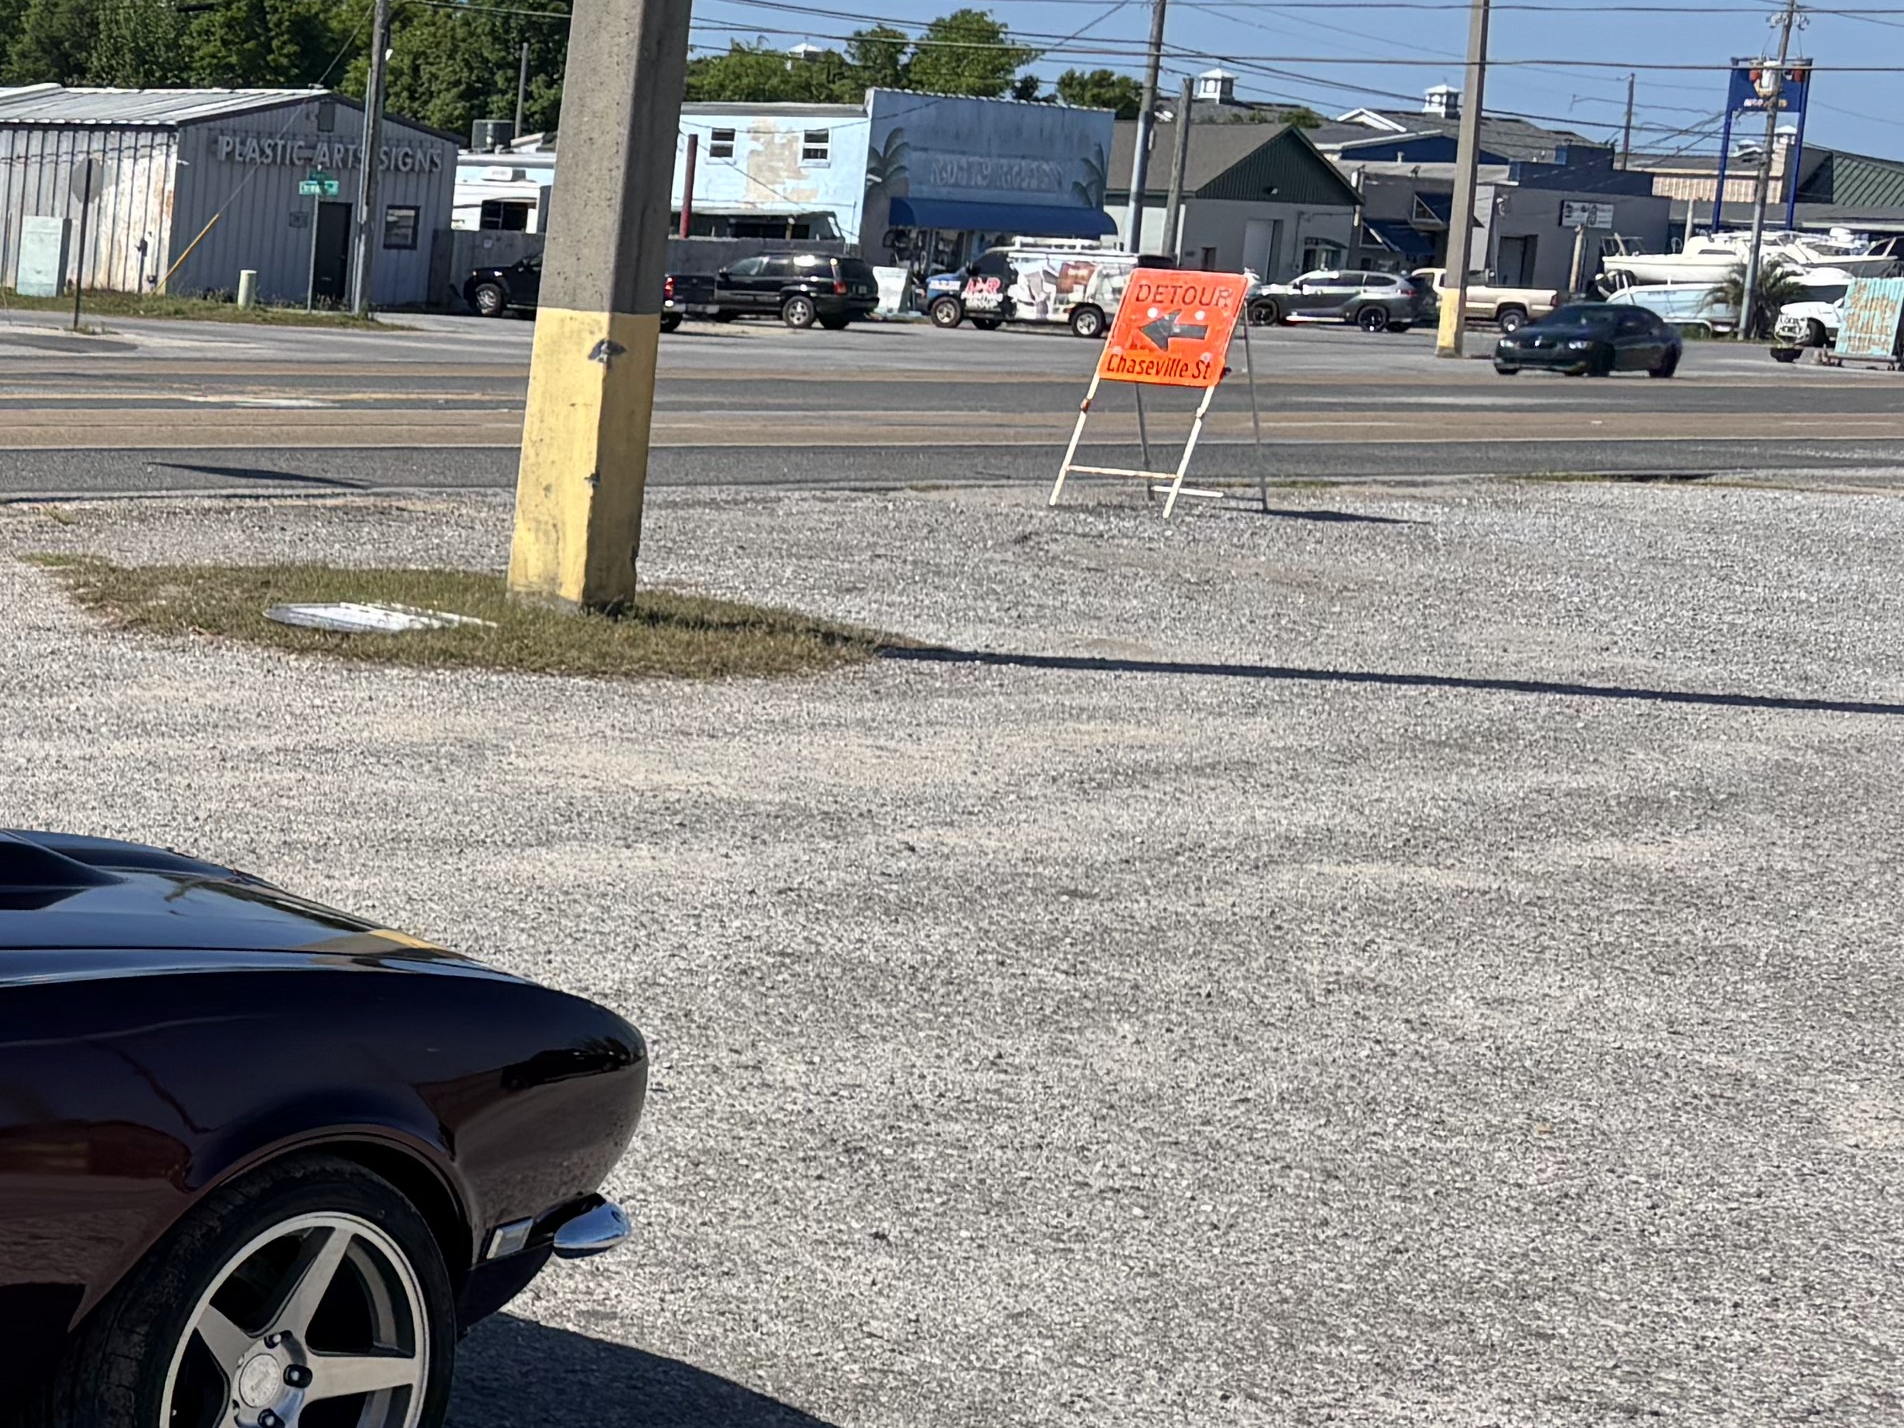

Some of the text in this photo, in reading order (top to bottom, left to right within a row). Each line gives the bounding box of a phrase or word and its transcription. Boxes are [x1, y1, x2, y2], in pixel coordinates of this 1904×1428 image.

[218, 135, 305, 165] PLASTIC
[379, 145, 443, 172] SIGNS
[1135, 284, 1231, 308] DETOUR
[1106, 353, 1189, 378] Chaseville
